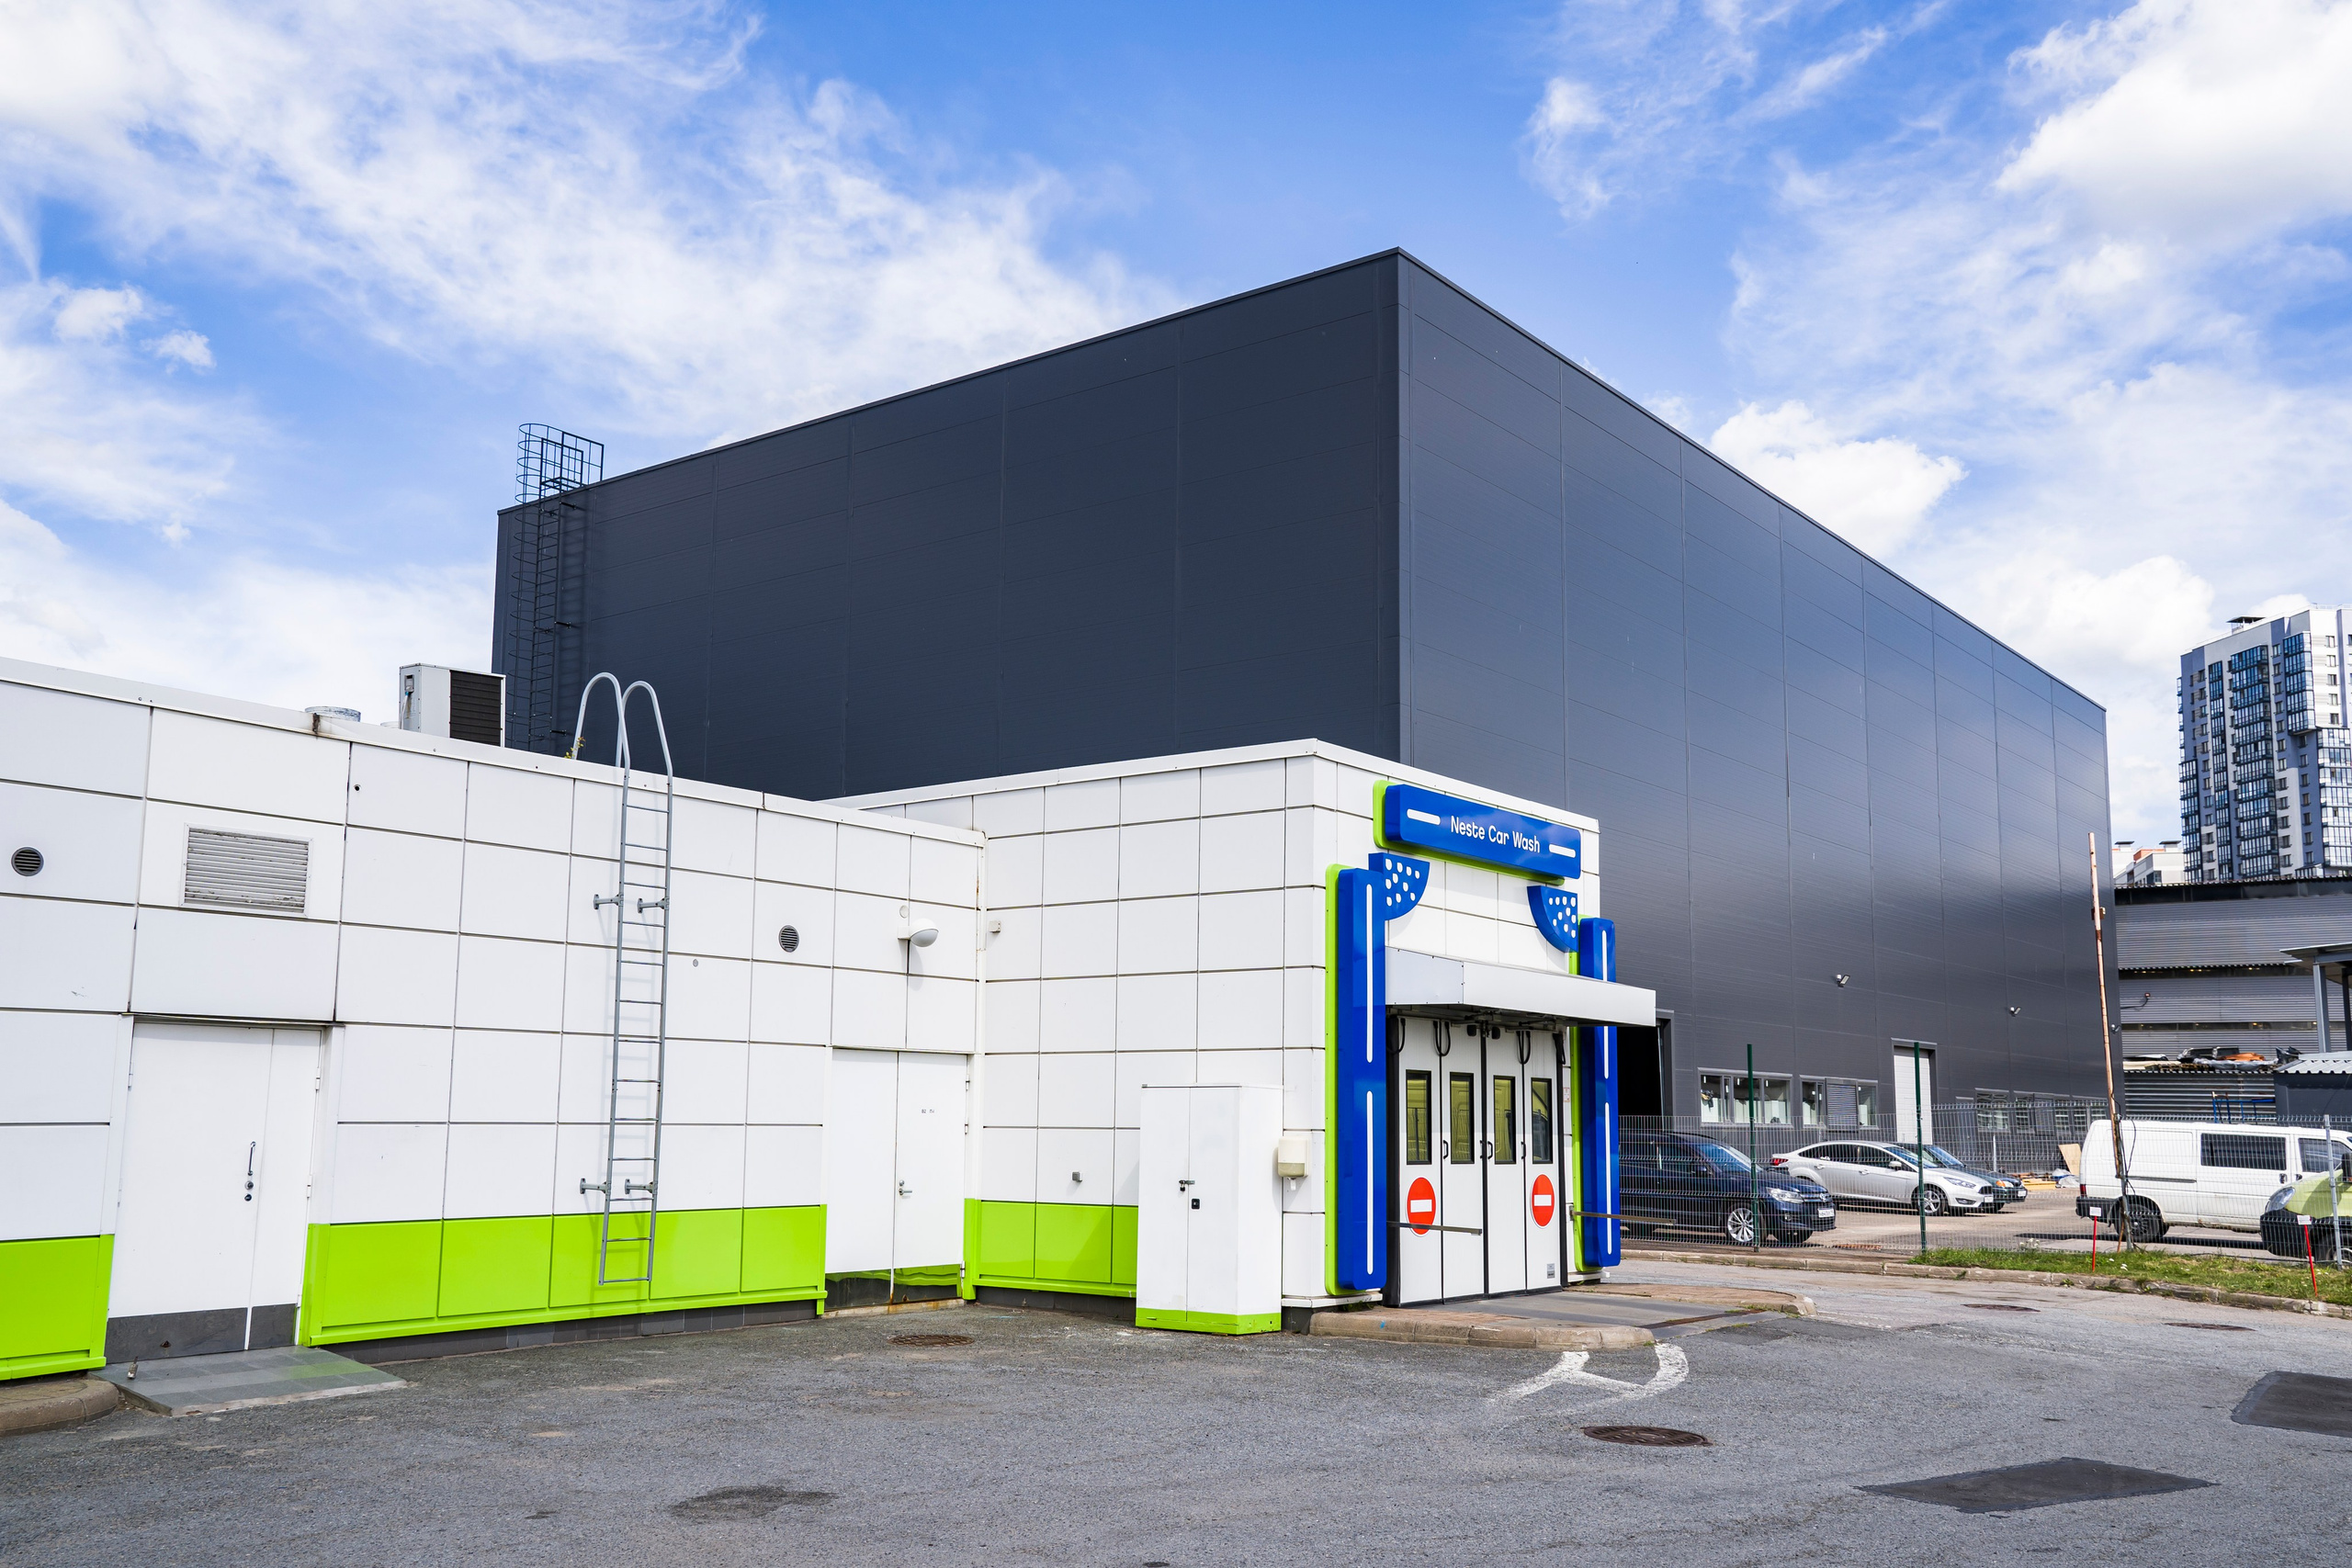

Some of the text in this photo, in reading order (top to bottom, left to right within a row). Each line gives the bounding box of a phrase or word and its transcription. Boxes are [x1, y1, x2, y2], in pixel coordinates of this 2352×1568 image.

[1451, 815, 1541, 853] Neste Car Wash
